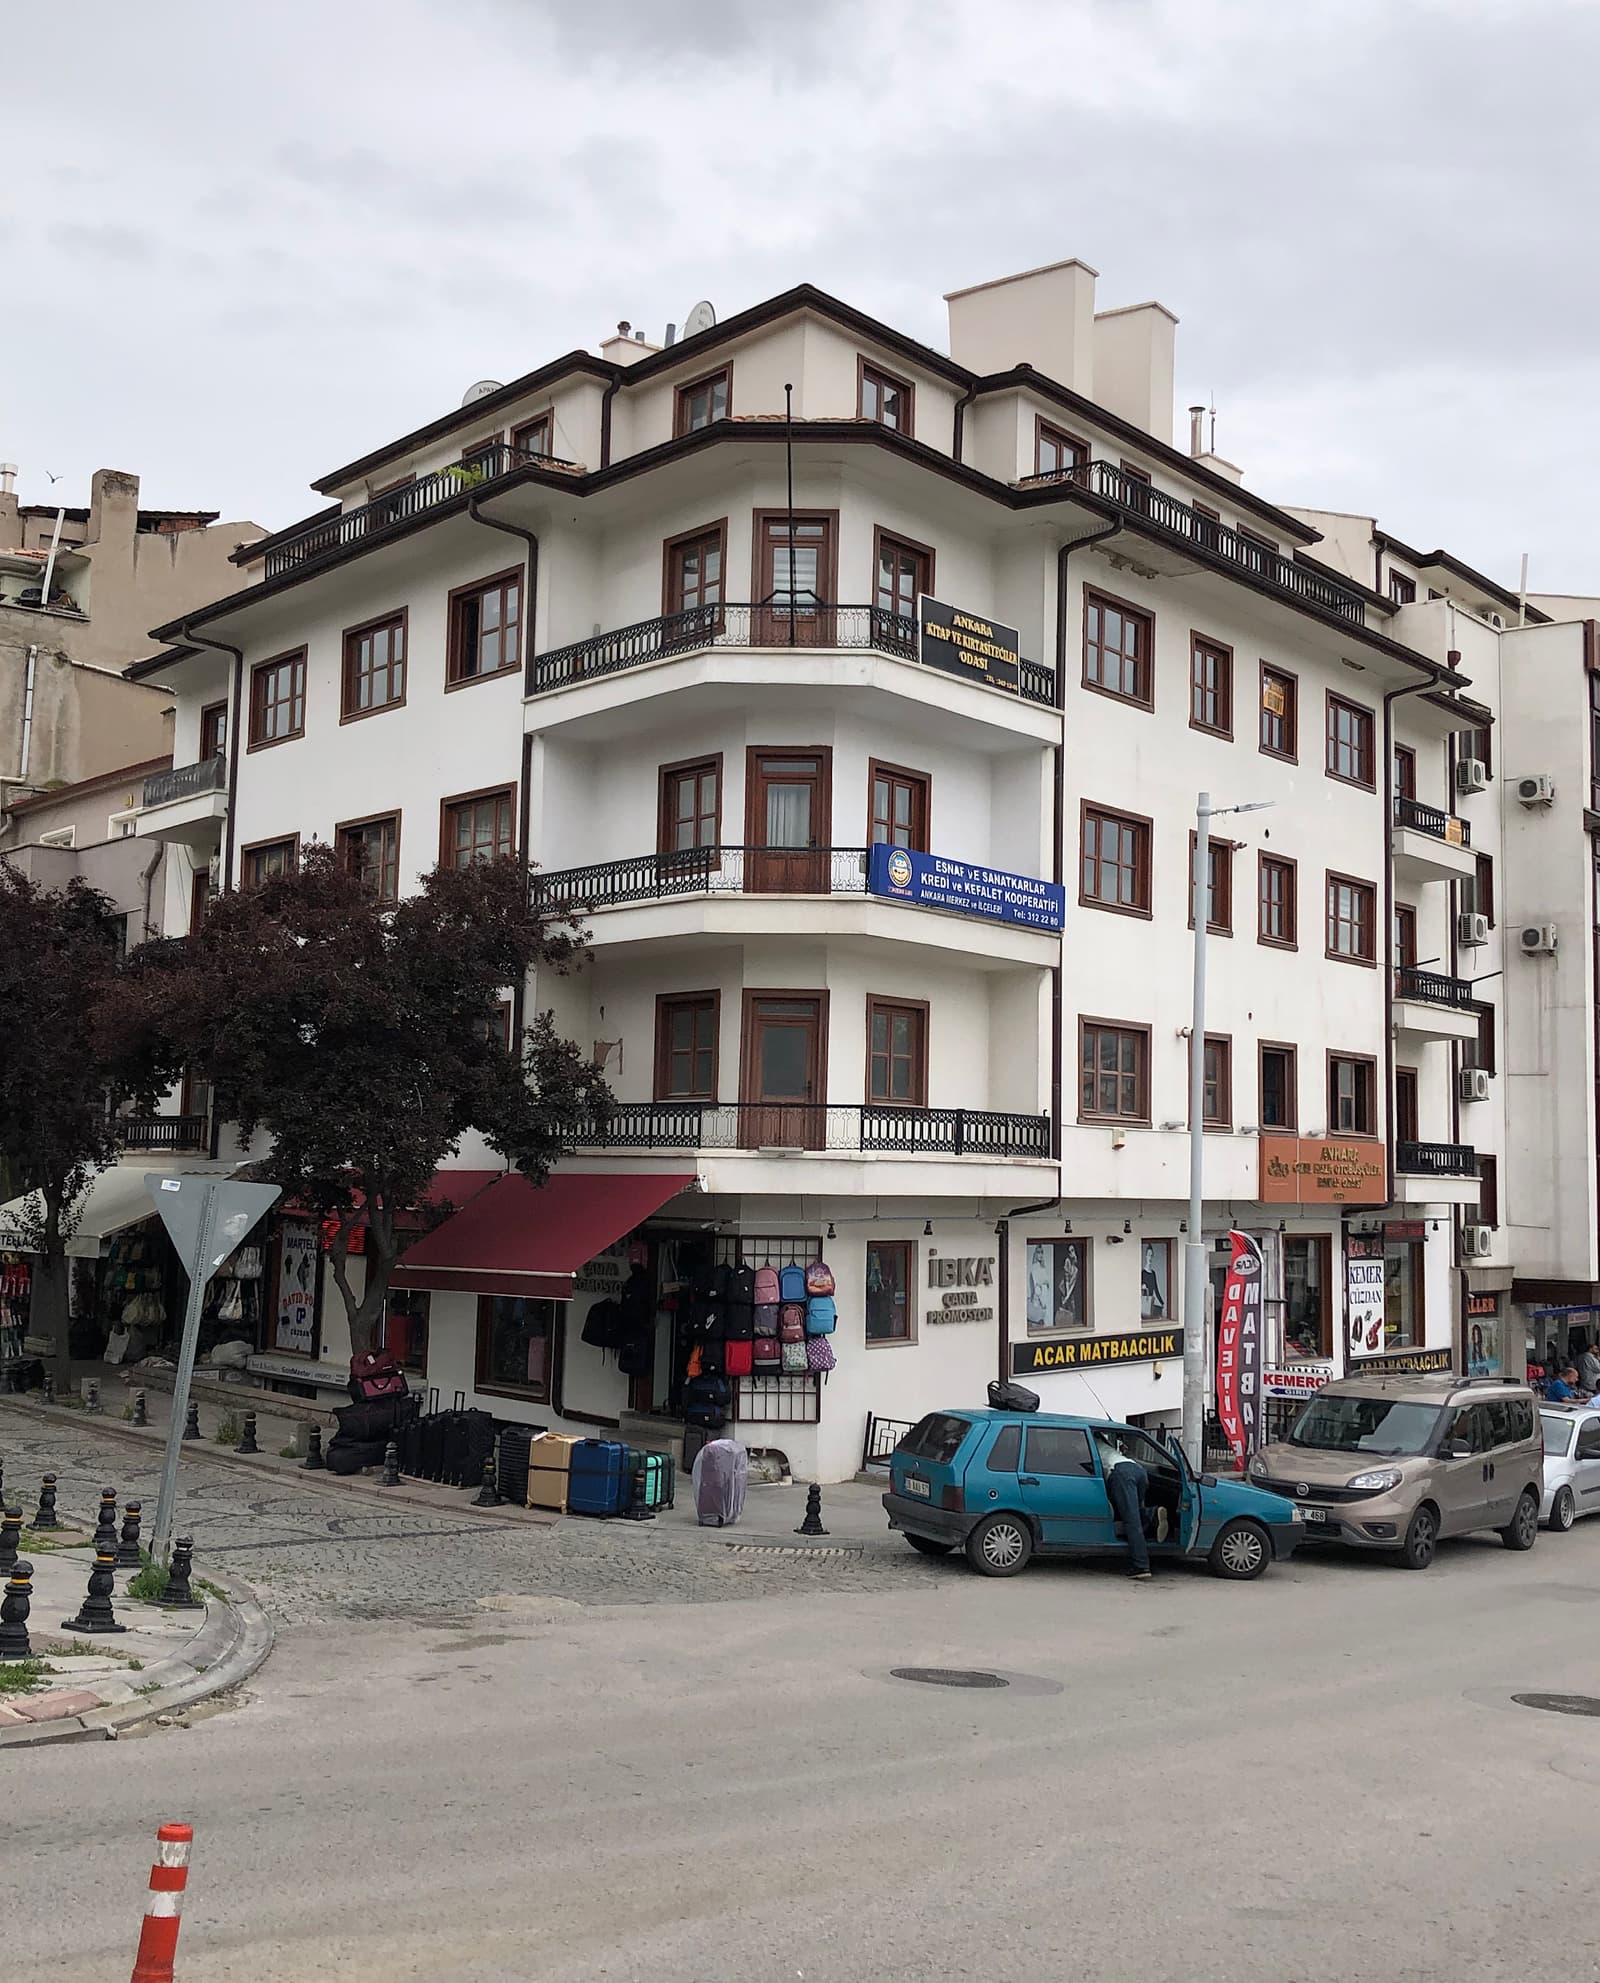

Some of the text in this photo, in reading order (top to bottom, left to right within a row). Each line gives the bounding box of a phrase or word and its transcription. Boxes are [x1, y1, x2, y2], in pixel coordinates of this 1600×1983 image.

[926, 621, 951, 641] KİTAP
[951, 630, 962, 646] VE
[953, 614, 994, 639] ANKARA
[959, 651, 988, 671] ODASI
[935, 860, 1046, 896] ESNAF VE SANATKARLAR
[920, 888, 945, 903] ANKARA
[946, 894, 970, 908] MERKEZ
[921, 872, 1059, 914] KREDİ ve KEFALET KOOPERATİFİ
[1013, 908, 1026, 920] Tel:
[1027, 911, 1039, 922] 312
[1039, 912, 1049, 924] 22
[928, 1248, 993, 1289] İBKA
[1350, 1266, 1382, 1284] KEMER
[942, 1291, 978, 1309] ÇANTA
[1350, 1288, 1382, 1304] CÜZDAN
[927, 1308, 993, 1325] PROMOSYON
[1033, 1335, 1174, 1367] ACAR MATBAACILIK
